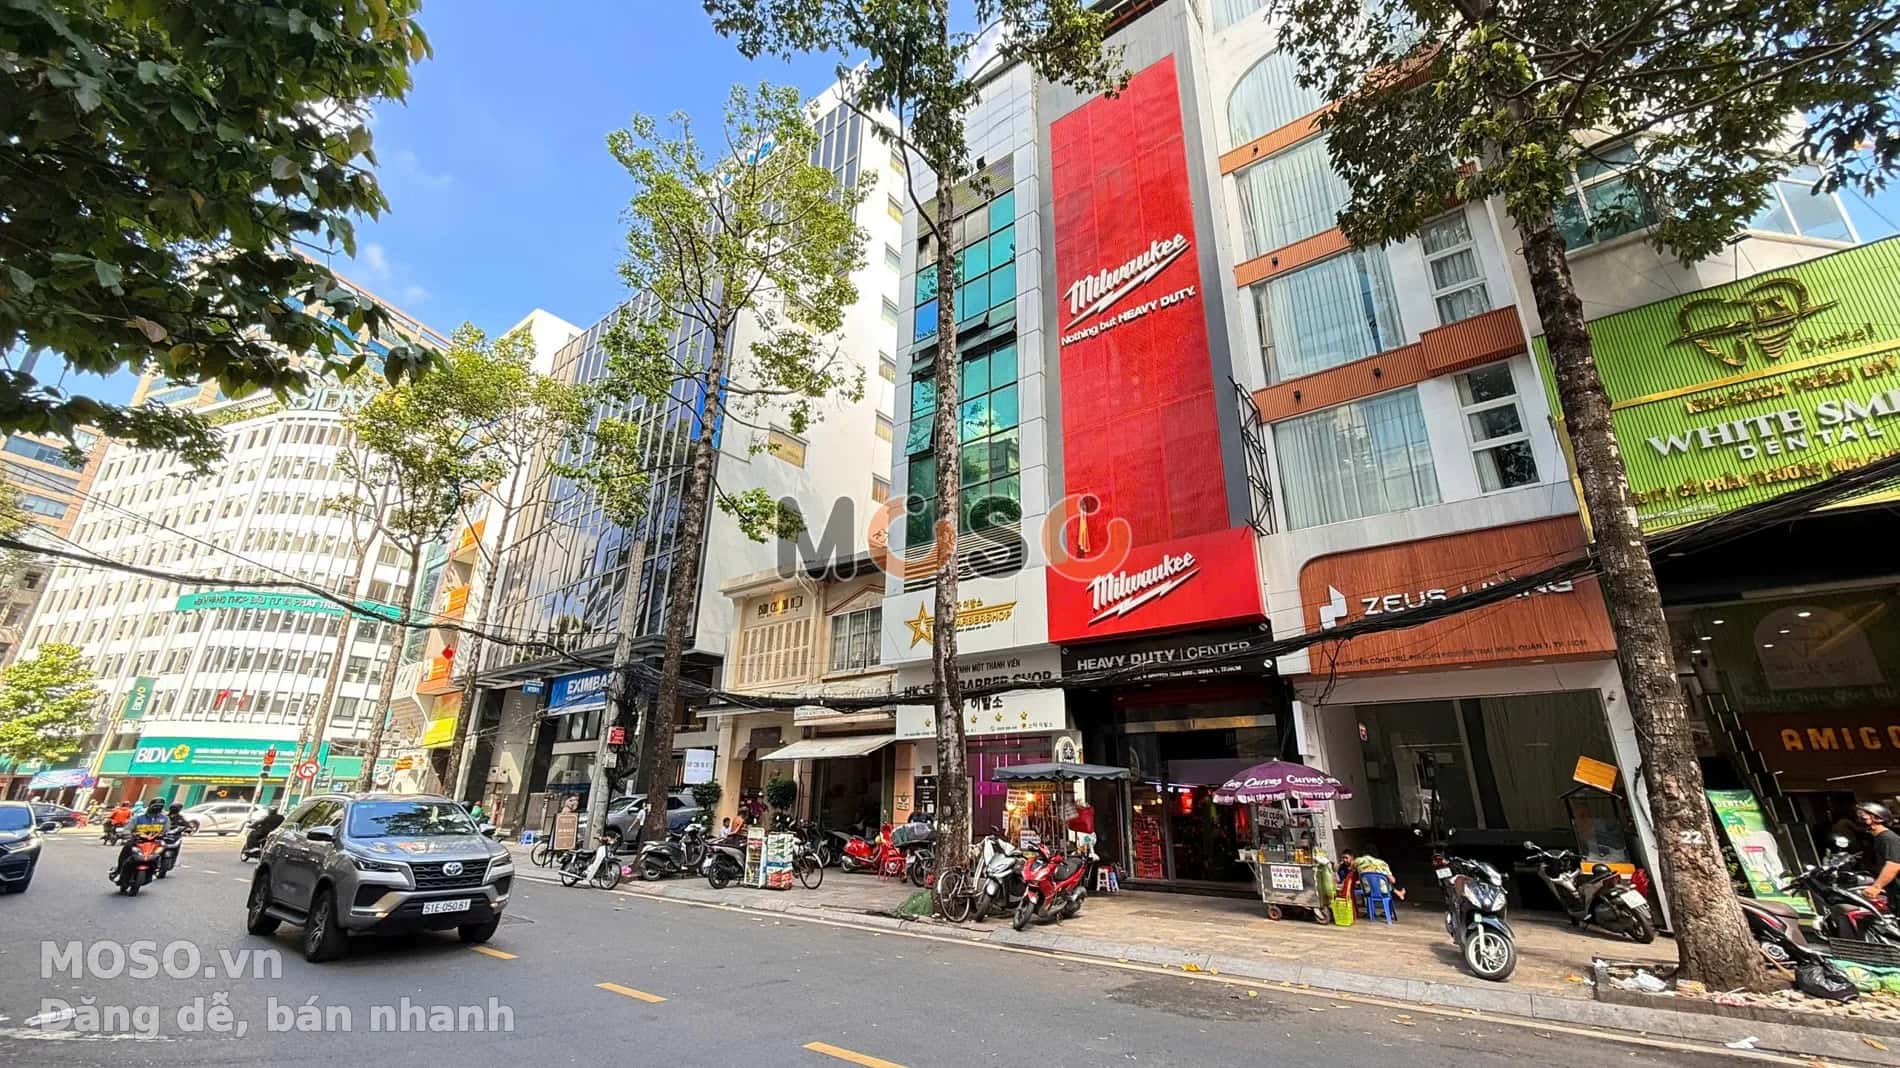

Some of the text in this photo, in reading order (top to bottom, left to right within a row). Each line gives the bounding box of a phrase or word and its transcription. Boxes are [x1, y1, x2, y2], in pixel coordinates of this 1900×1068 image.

[1063, 233, 1187, 314] Milwaukee
[1061, 326, 1098, 346] Nothing
[1100, 317, 1118, 332] but
[1117, 300, 1157, 323] HEAVY
[1647, 408, 1807, 458] WHITE
[1739, 421, 1884, 460] DENTAL
[1087, 551, 1196, 611] Milwaukee
[1361, 588, 1447, 616] ZEUS
[1077, 655, 1126, 671] HEAVY
[1130, 649, 1175, 666] DUTY
[135, 747, 173, 764] BIDV
